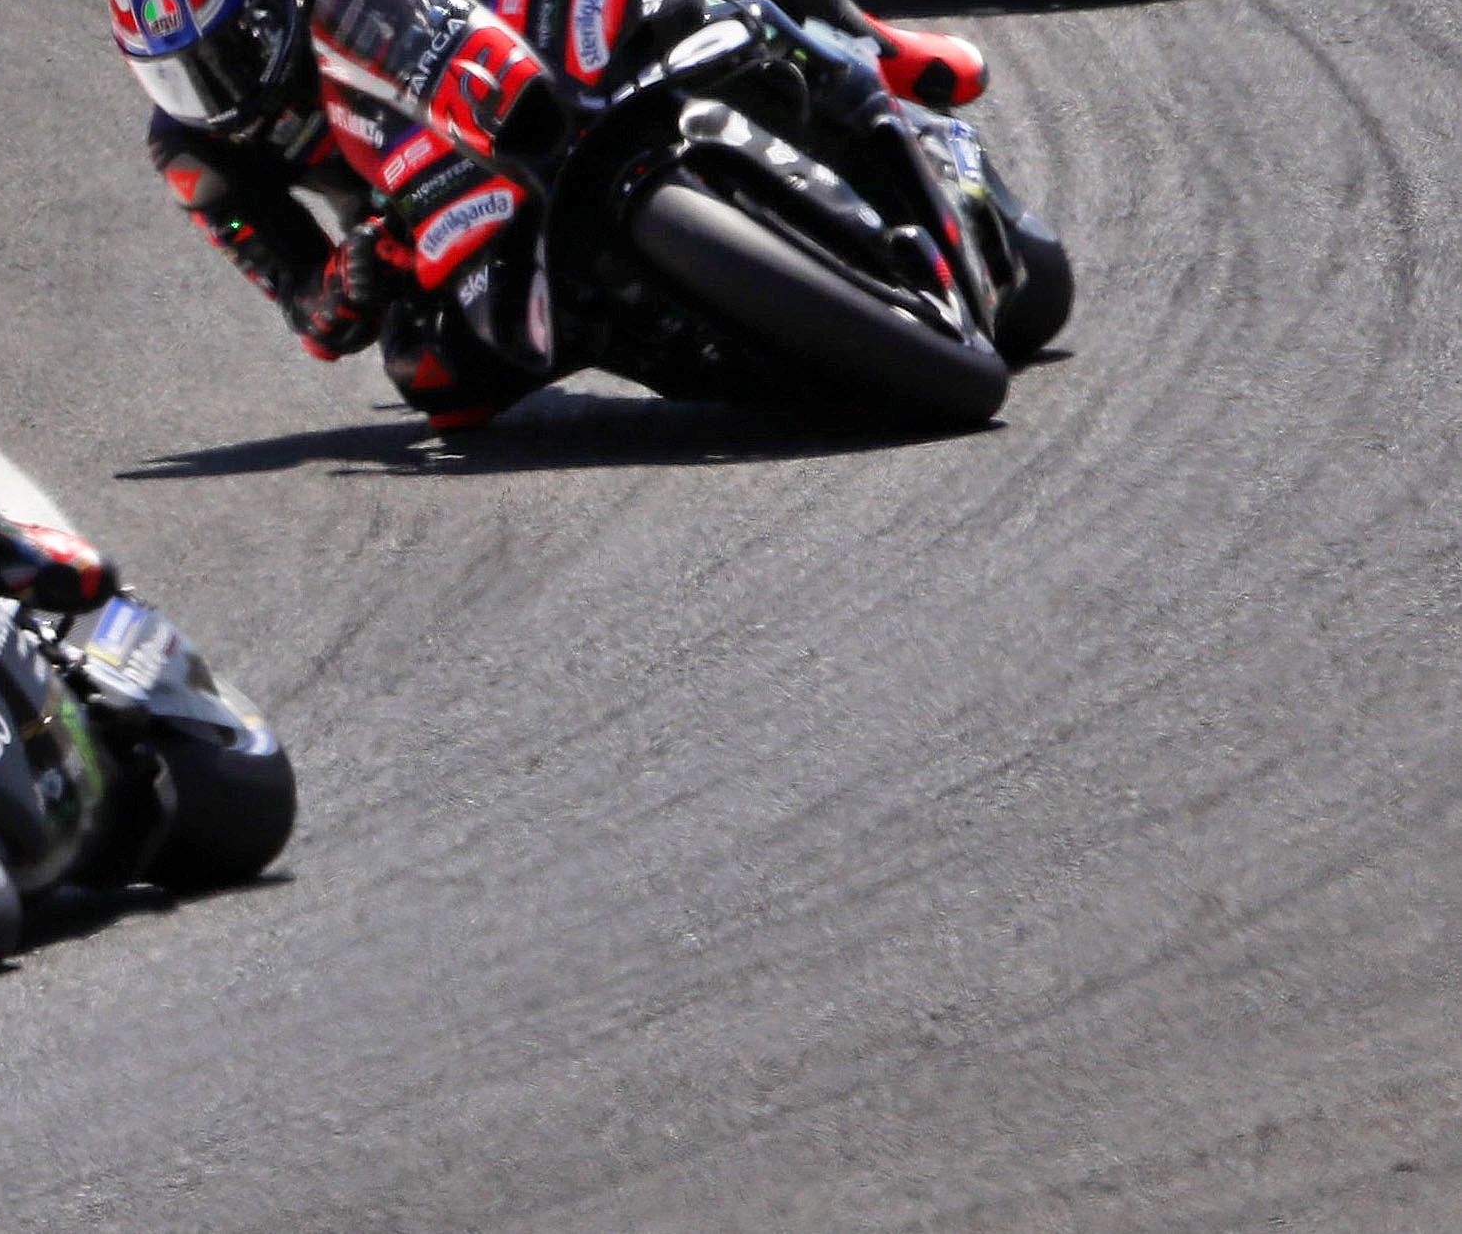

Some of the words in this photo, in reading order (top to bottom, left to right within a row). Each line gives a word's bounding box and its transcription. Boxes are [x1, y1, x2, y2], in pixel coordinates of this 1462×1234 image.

[406, 18, 468, 98] ARGA
[422, 194, 509, 253] sterilgarda
[458, 265, 489, 307] sky
